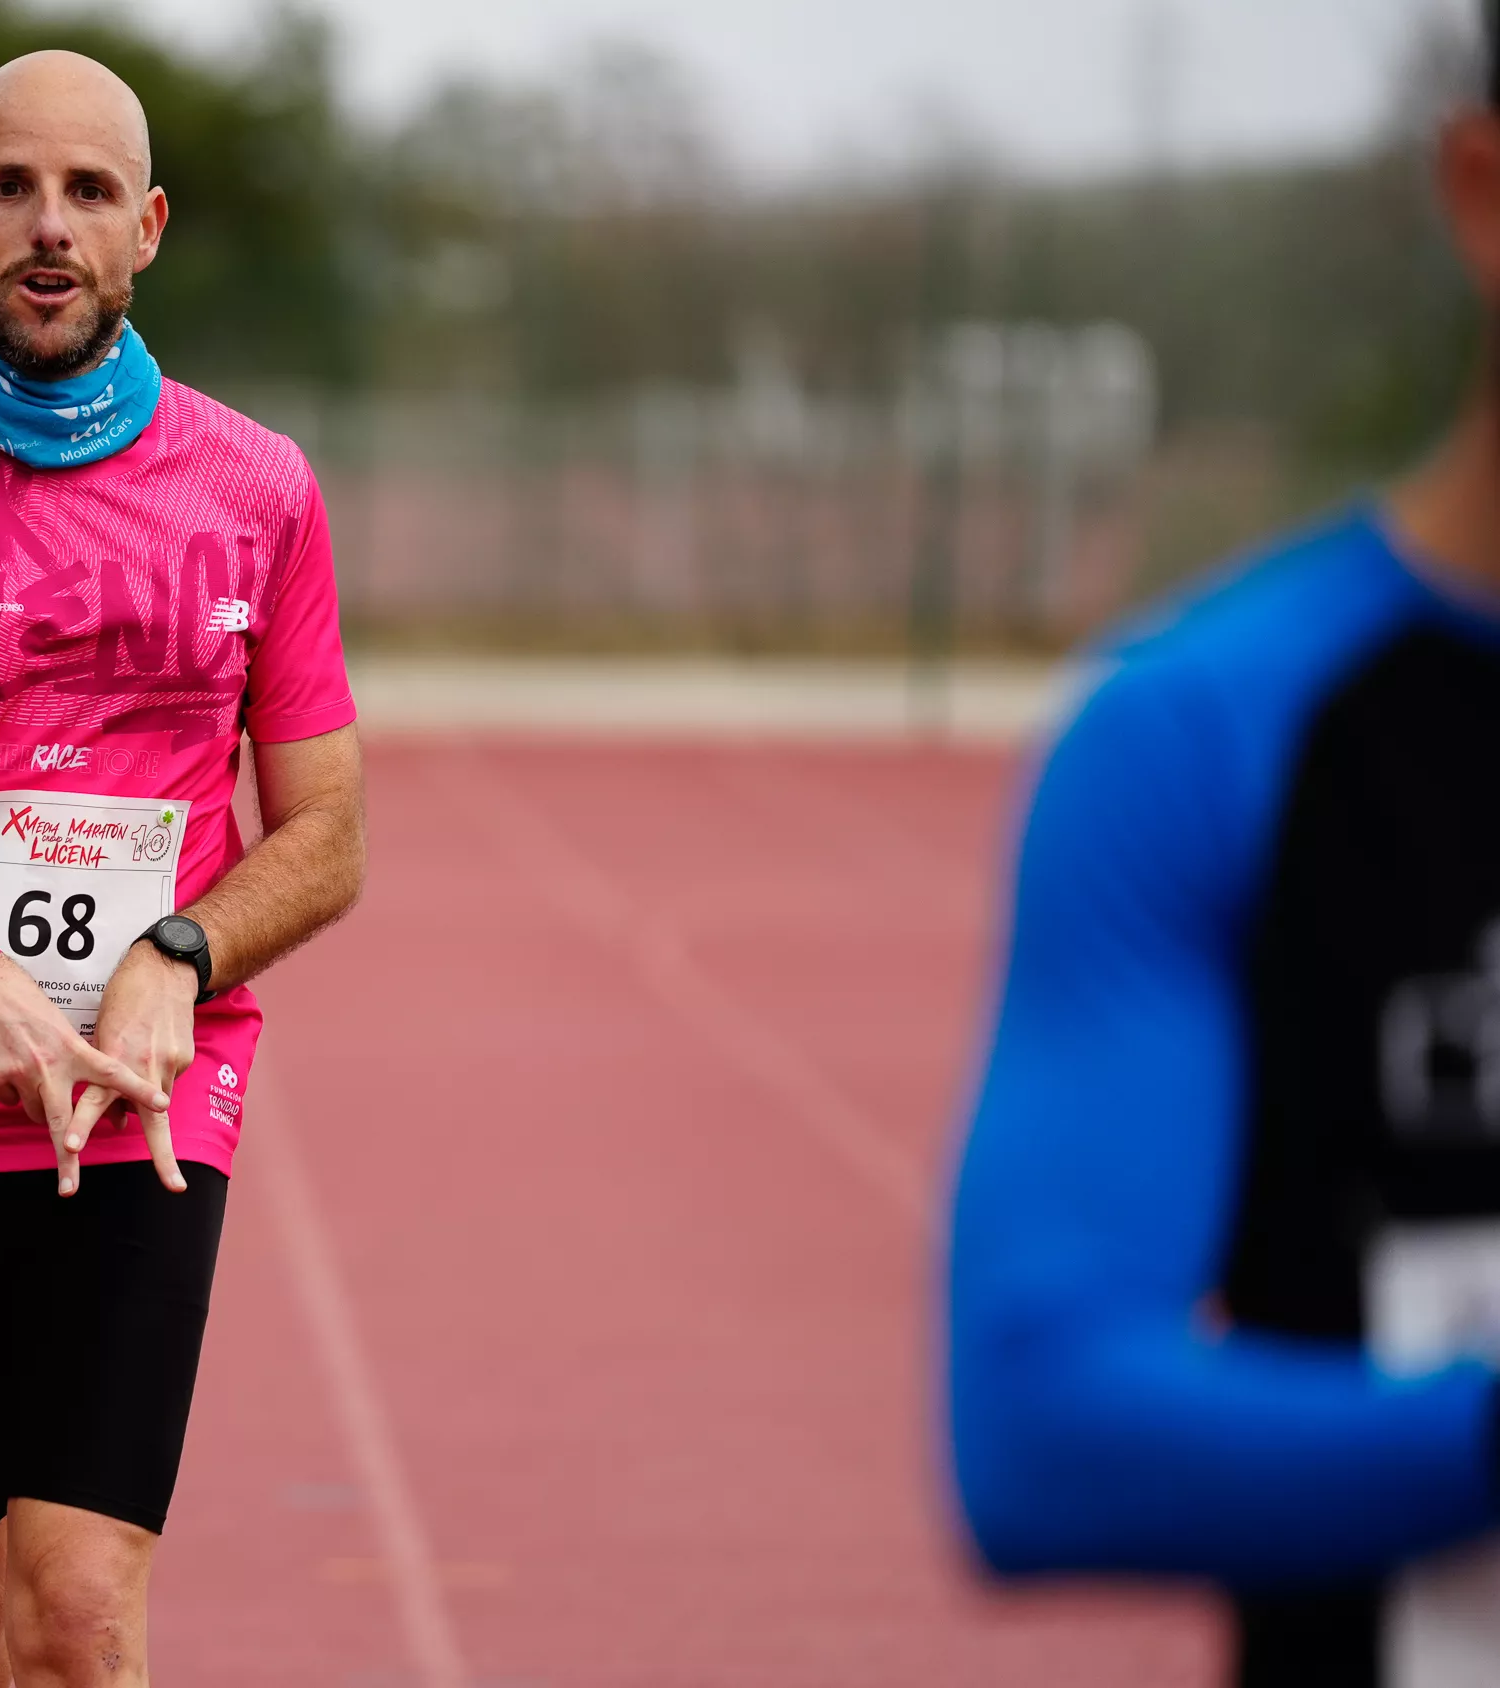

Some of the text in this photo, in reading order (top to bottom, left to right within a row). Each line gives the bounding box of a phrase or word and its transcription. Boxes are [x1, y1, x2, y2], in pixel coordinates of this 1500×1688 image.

[60, 417, 133, 462] Mobility Cars
[30, 743, 93, 771] RACE
[95, 748, 135, 776] TO
[135, 750, 161, 779] BE
[30, 837, 111, 868] LUCENA
[8, 890, 96, 961] 68
[73, 981, 106, 993] GÁLVEZ
[208, 1094, 240, 1115] TRINIDAD
[209, 1108, 234, 1127] ALFONSO
